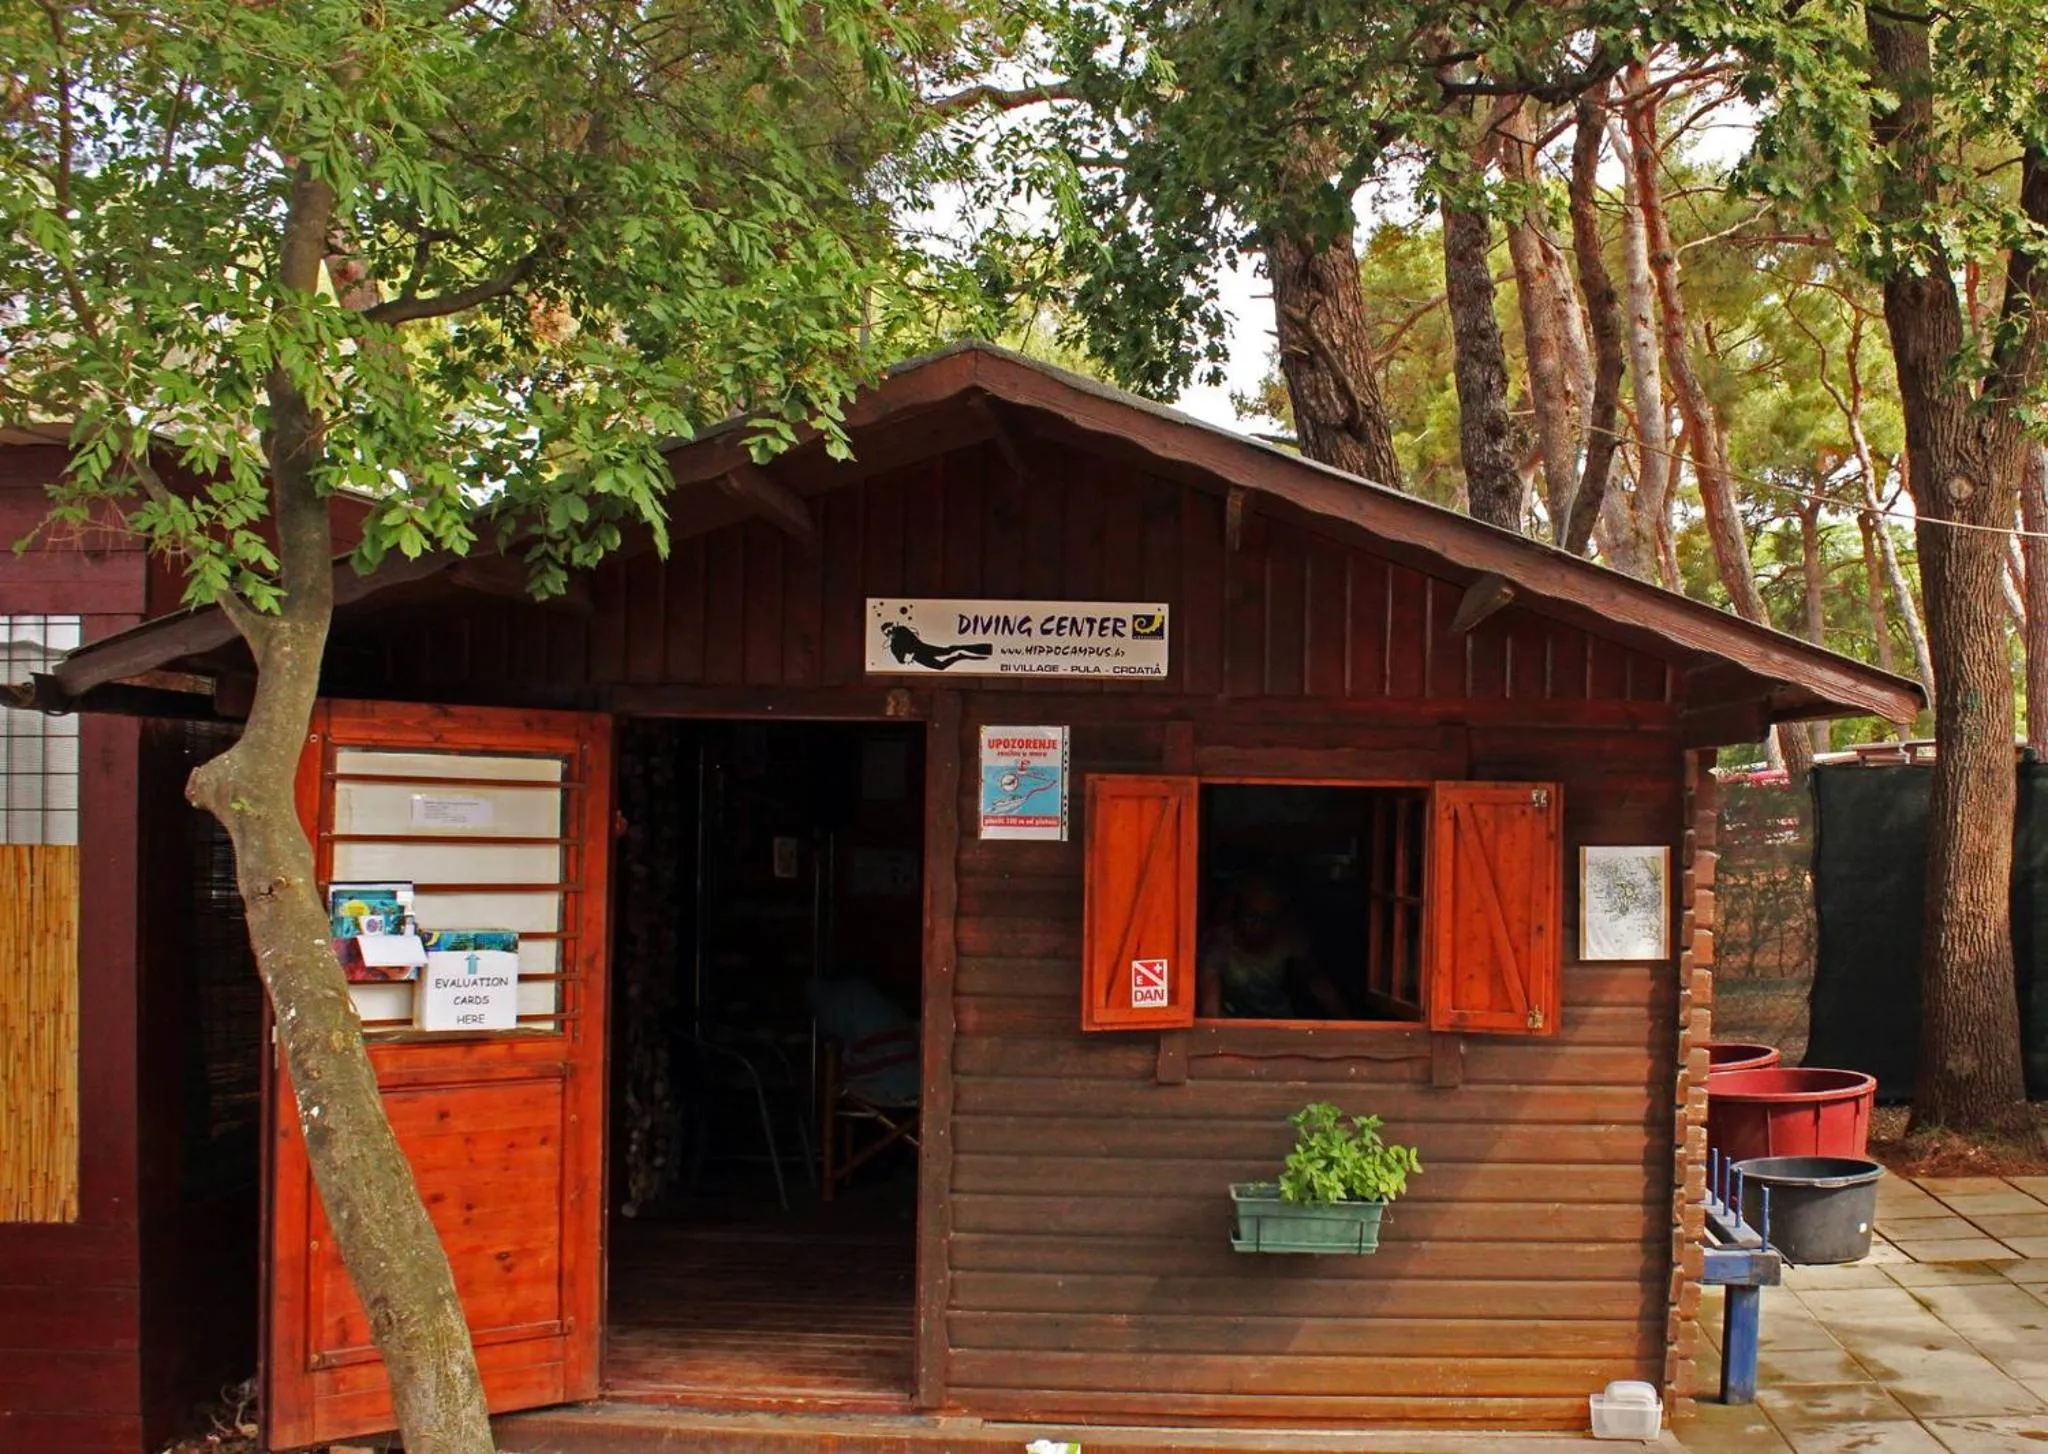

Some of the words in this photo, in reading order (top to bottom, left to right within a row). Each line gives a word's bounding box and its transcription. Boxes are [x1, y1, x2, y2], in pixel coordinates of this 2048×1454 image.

[957, 613, 1033, 638] DIVING
[1039, 615, 1127, 639] CENTER
[1012, 664, 1060, 673] VILLAGE
[1070, 665, 1101, 674] PULA
[988, 738, 1058, 750] UPOZORENJE
[435, 977, 509, 989] EVALUATION
[453, 995, 490, 1006] CARDS
[1135, 988, 1164, 1002] DAN
[456, 1013, 486, 1025] HERE
